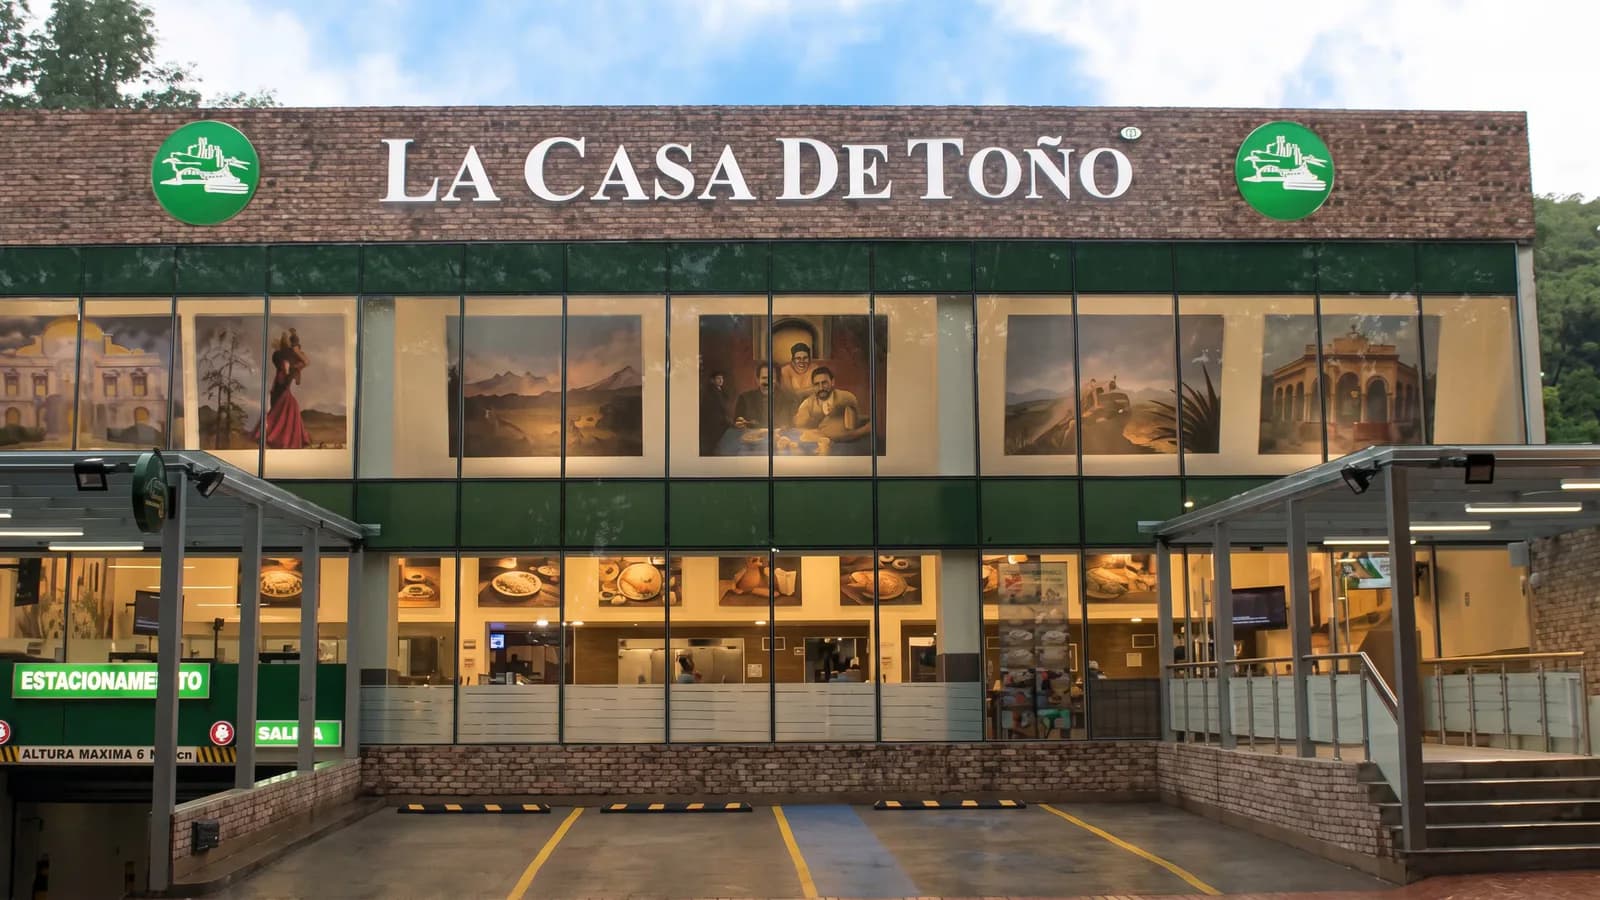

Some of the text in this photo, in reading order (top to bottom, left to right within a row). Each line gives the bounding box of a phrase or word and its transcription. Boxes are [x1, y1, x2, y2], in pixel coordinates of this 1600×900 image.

[379, 135, 1133, 202] LA CASA DE TOÑO
[21, 671, 202, 690] ESTACIONAMETO
[258, 726, 324, 741] SALIA
[22, 749, 74, 760] ALTURA
[79, 749, 133, 760] MAXIMA
[136, 749, 144, 760] 6
